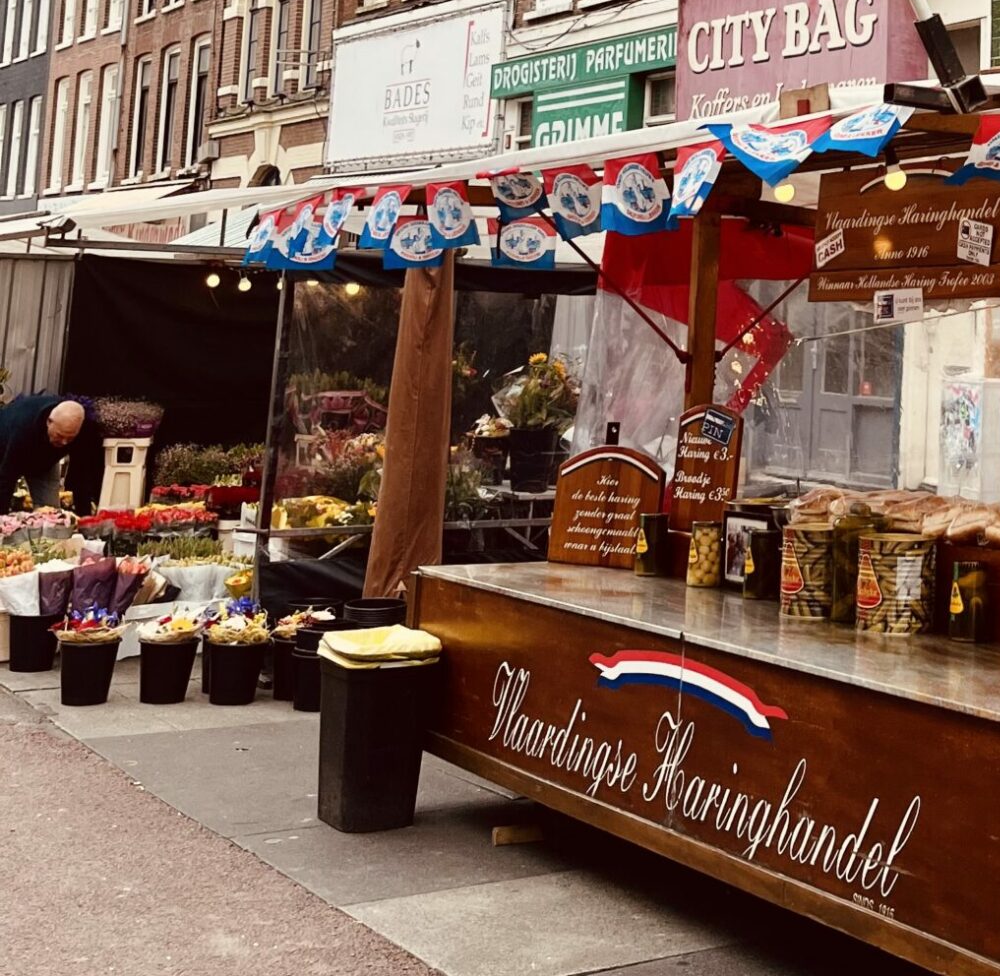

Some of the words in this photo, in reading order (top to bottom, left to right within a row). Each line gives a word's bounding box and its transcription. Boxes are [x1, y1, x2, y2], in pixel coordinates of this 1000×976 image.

[687, 8, 776, 73] CITY
[494, 52, 577, 92] DROGISTERIJ
[384, 81, 431, 110] BADES
[689, 86, 747, 121] Koffers
[825, 210, 896, 235] Vlaardingse
[898, 197, 1000, 231] Haringhandel
[818, 238, 843, 263] CASH
[874, 248, 904, 261] Anno
[906, 245, 930, 259] 1916
[817, 276, 854, 290] Winnaar
[855, 274, 900, 289] Hollandse
[901, 272, 936, 293] Haring
[938, 271, 968, 292] Trofee
[970, 274, 995, 285] 2003
[703, 424, 724, 439] PIN
[678, 446, 710, 463] Haring
[596, 475, 619, 486] Hier
[675, 470, 711, 488] Broodje
[571, 489, 583, 500] de
[607, 491, 641, 509] haring
[673, 487, 706, 504] Haring
[573, 507, 606, 521] zonder
[488, 661, 637, 798] Vlaardingse
[642, 710, 921, 897] Haringhandel
